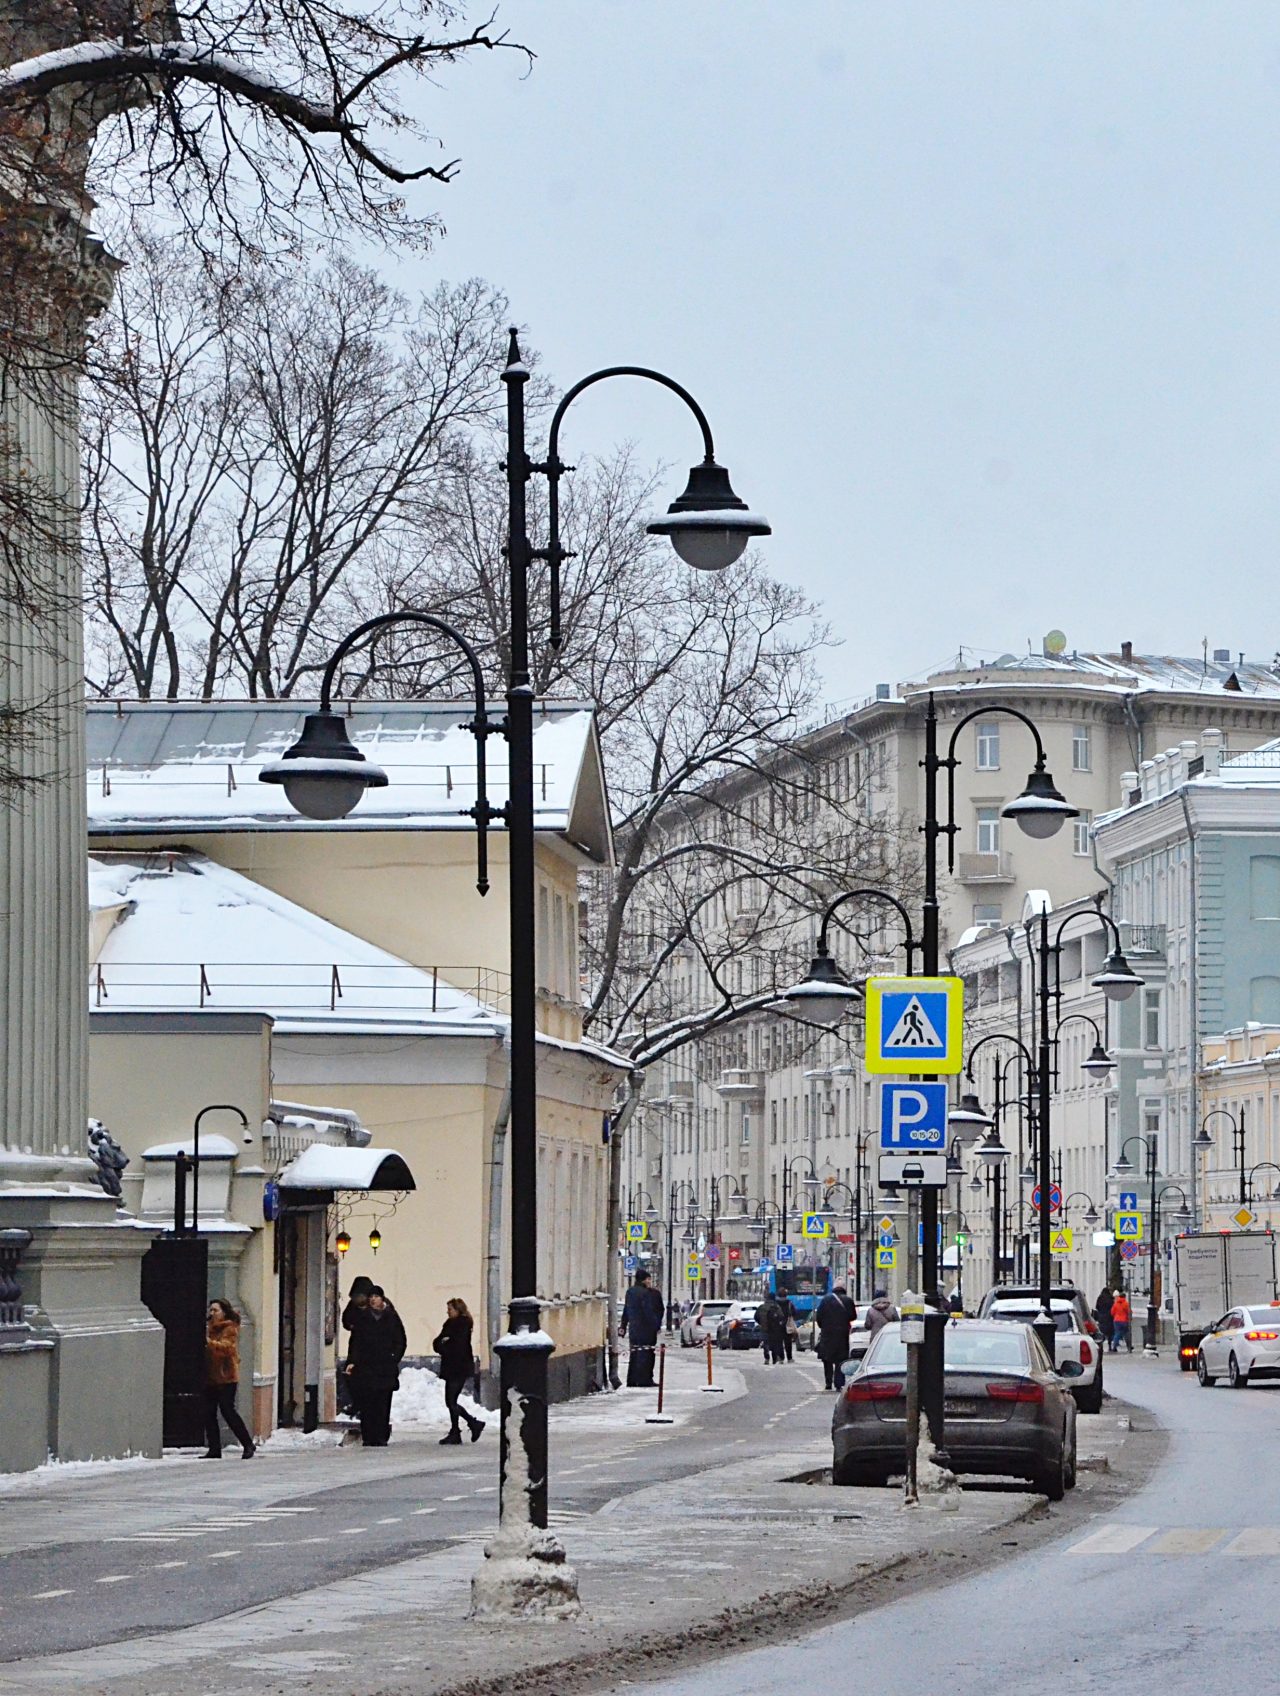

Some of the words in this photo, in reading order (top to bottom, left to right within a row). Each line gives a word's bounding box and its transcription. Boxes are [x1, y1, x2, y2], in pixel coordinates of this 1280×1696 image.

[892, 1090, 929, 1142] P
[928, 1130, 939, 1140] 20
[779, 1246, 789, 1259] P
